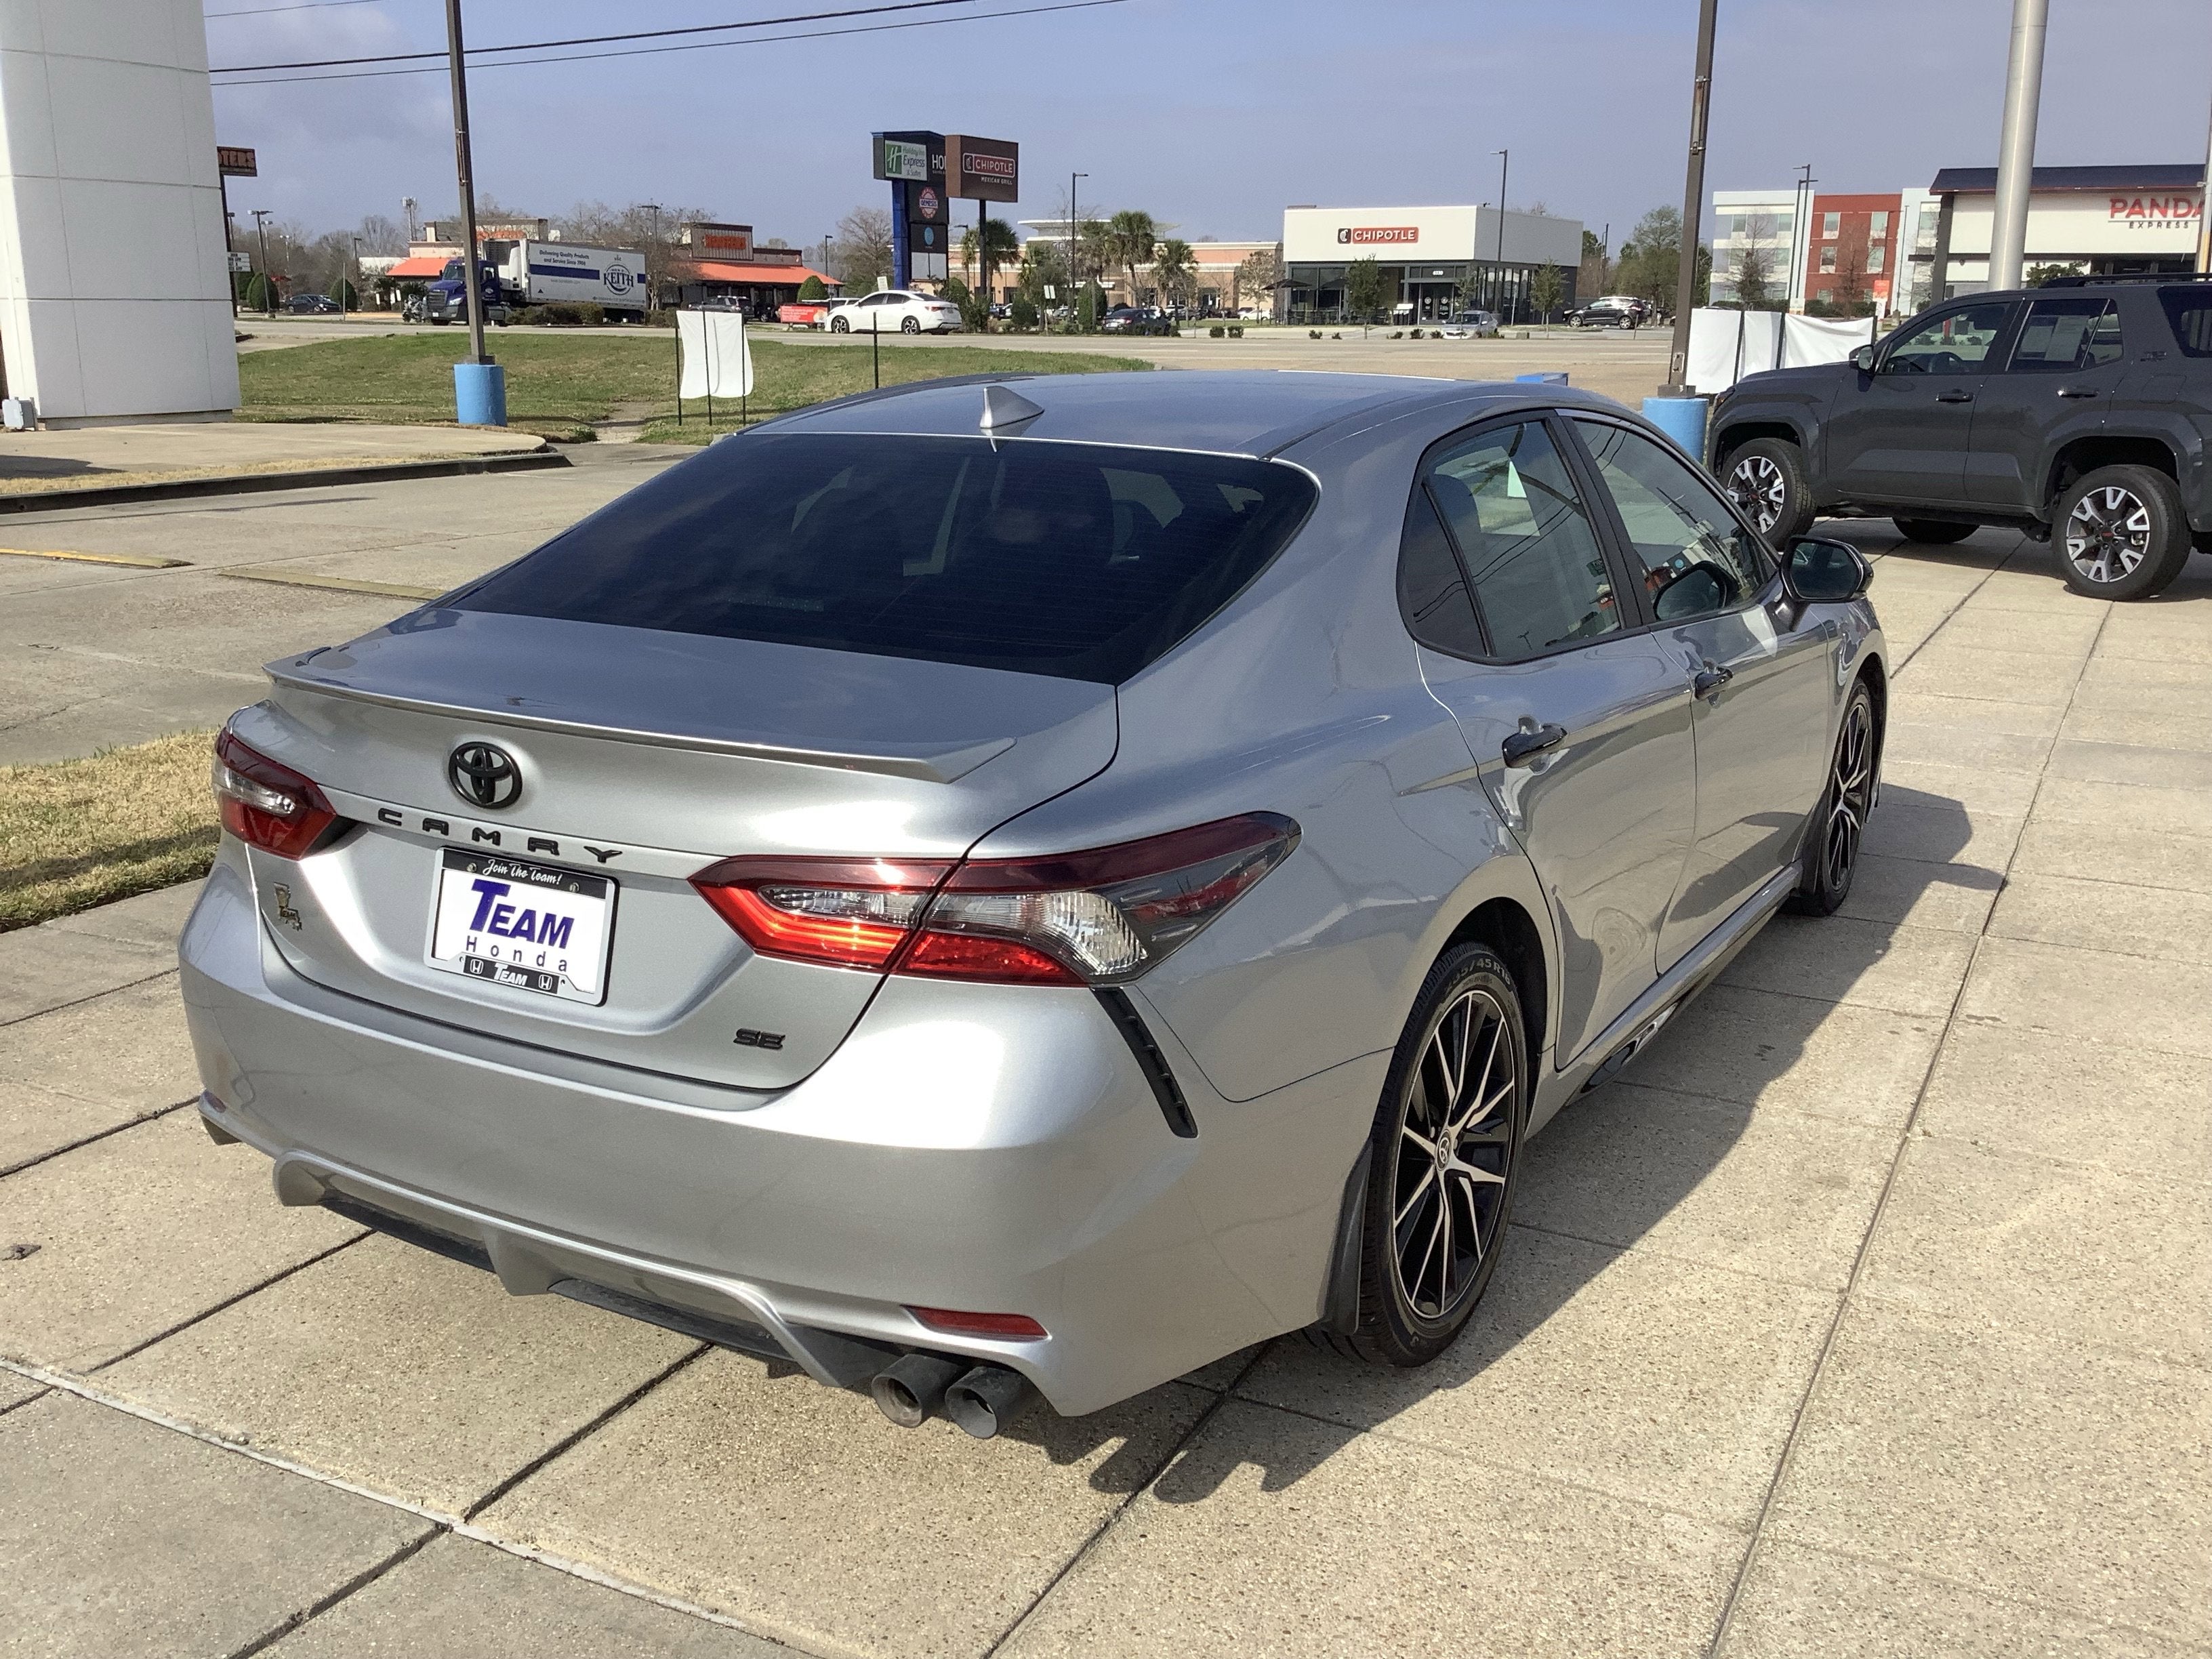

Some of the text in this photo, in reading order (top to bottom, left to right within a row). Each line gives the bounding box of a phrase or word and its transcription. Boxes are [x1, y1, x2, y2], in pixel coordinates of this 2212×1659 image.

[903, 155, 925, 168] Express
[976, 159, 1012, 173] CHIPOTLE
[1355, 230, 1415, 241] CHIPOTLE
[604, 272, 634, 287] KEITH
[377, 807, 623, 863] CAMRY
[483, 859, 562, 885] Join The Team!
[470, 878, 575, 949] TEAM
[466, 935, 567, 972] Honda
[493, 962, 528, 986] TEAM
[733, 1027, 786, 1050] SE
